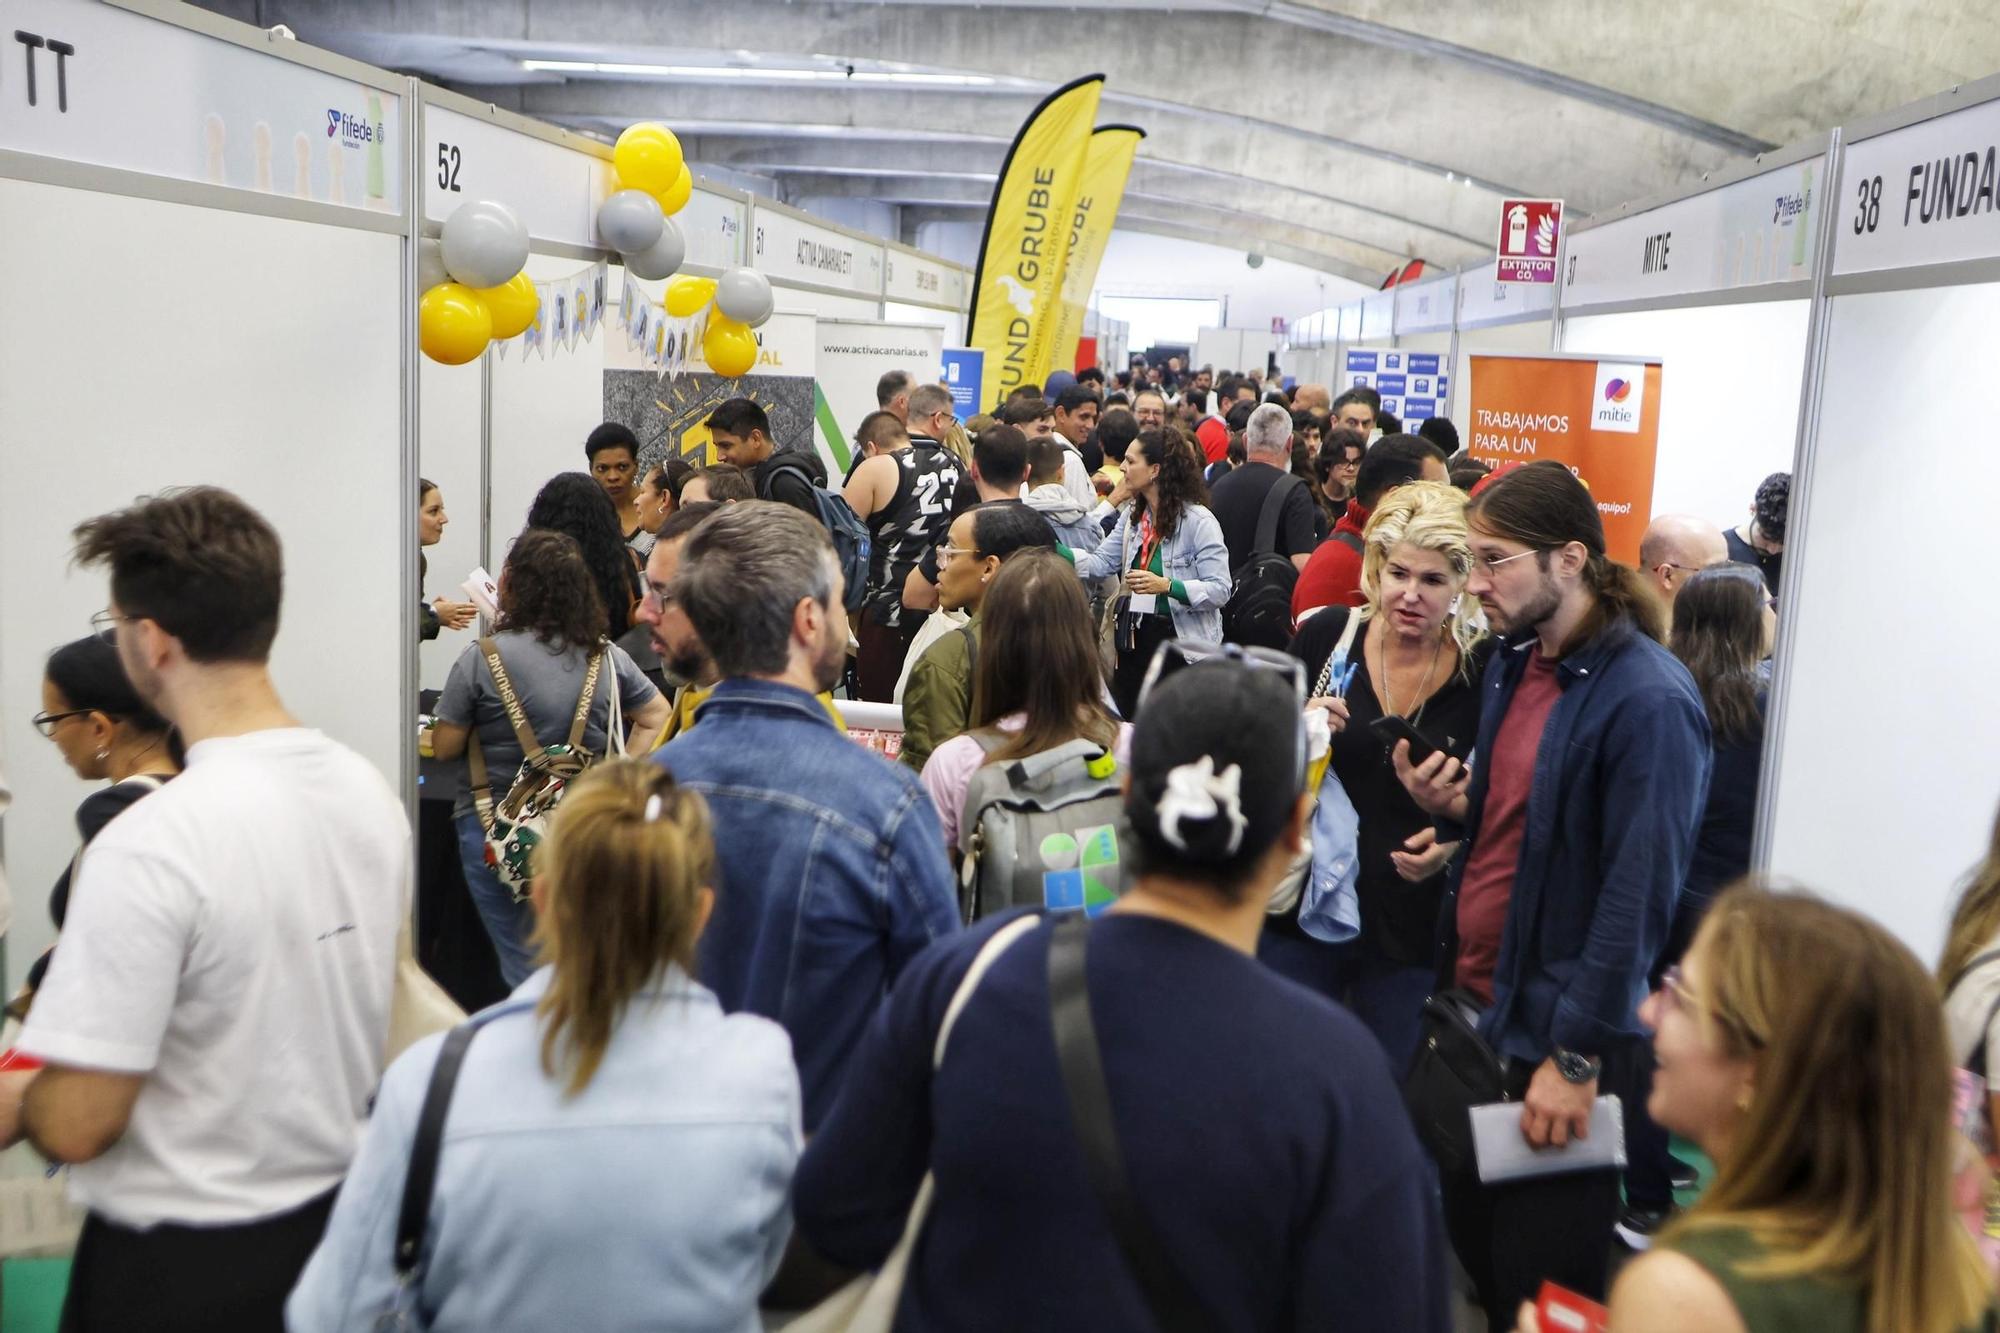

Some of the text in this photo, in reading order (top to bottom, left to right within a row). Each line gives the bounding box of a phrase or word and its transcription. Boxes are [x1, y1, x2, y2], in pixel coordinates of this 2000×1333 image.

[342, 113, 372, 142] fifede
[438, 142, 461, 192] 52
[1854, 146, 2000, 235] 38 FUNDA
[1018, 168, 1054, 282] GRUBE
[757, 226, 764, 255] 51
[1642, 231, 1672, 275] MITIE
[1501, 260, 1552, 272] EXTINTOR
[823, 344, 929, 357] www.activacanarias.es
[1477, 409, 1569, 434] TRABAJAMOS
[1599, 407, 1632, 422] mitie
[1474, 433, 1537, 455] PARA UN
[914, 468, 959, 515] 23
[1597, 501, 1632, 515] equipo?
[487, 652, 527, 730] YANSHUANG
